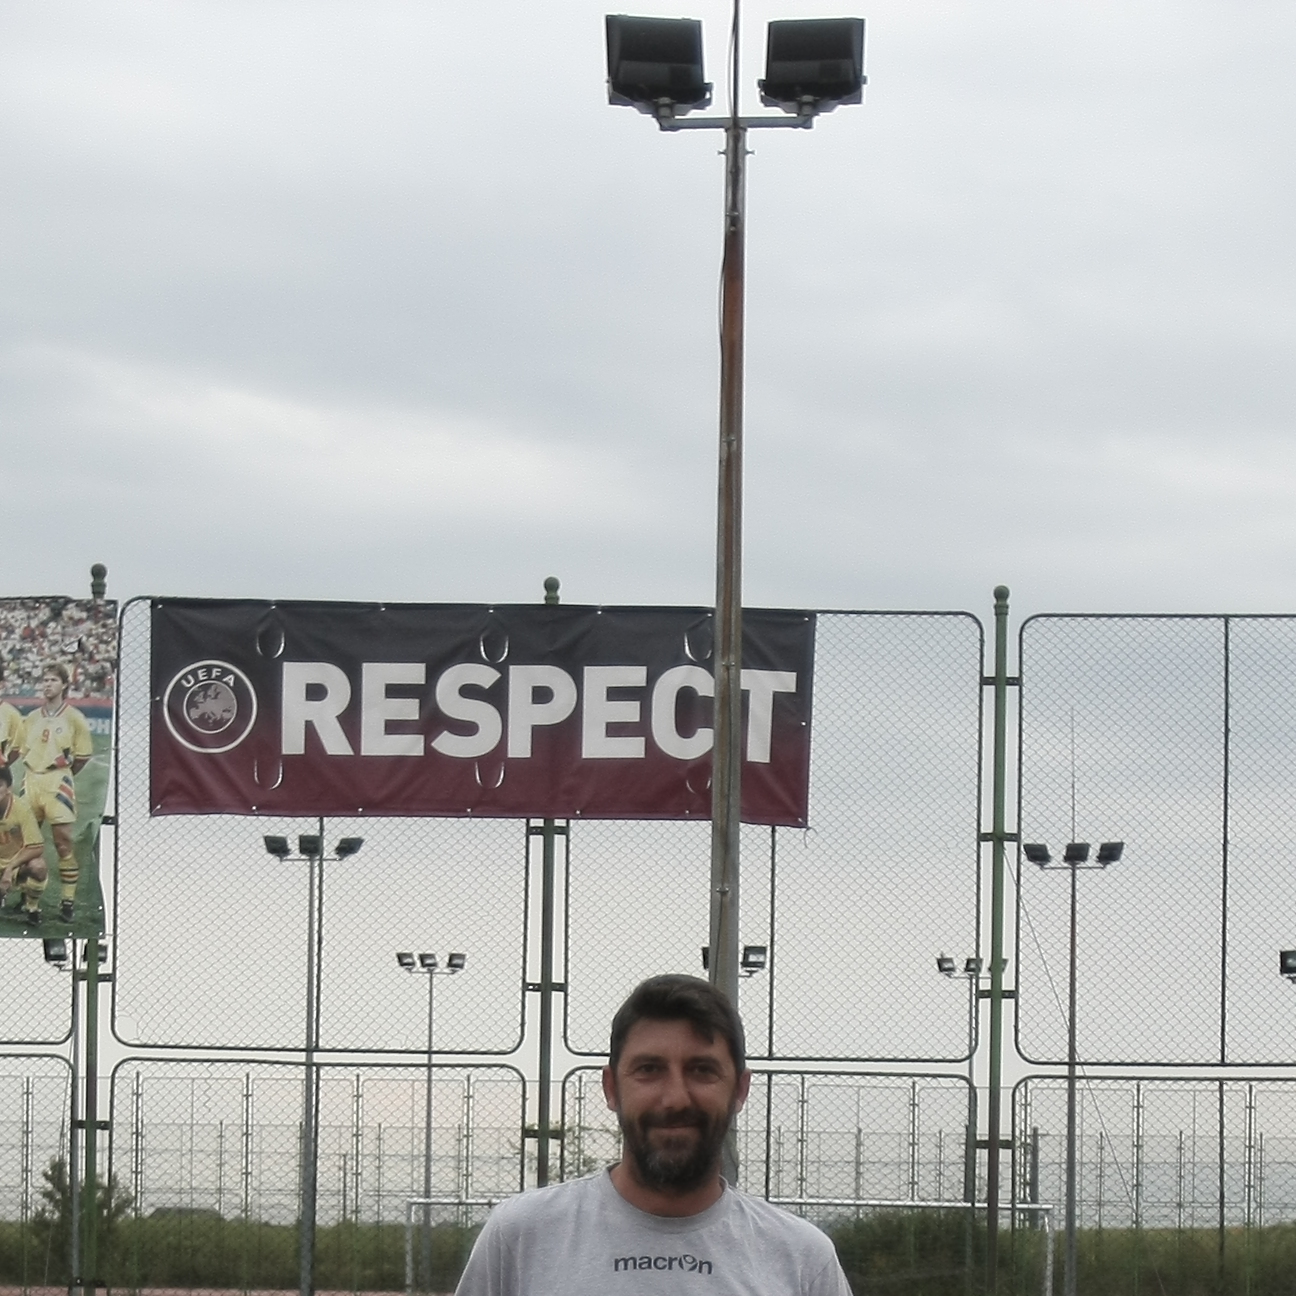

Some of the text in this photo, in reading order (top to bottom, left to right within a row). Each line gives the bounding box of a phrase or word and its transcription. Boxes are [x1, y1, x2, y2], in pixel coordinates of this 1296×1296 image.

[181, 668, 235, 688] UEFA
[281, 662, 797, 763] RESPECT
[41, 729, 50, 743] 9
[614, 1254, 713, 1275] macron
